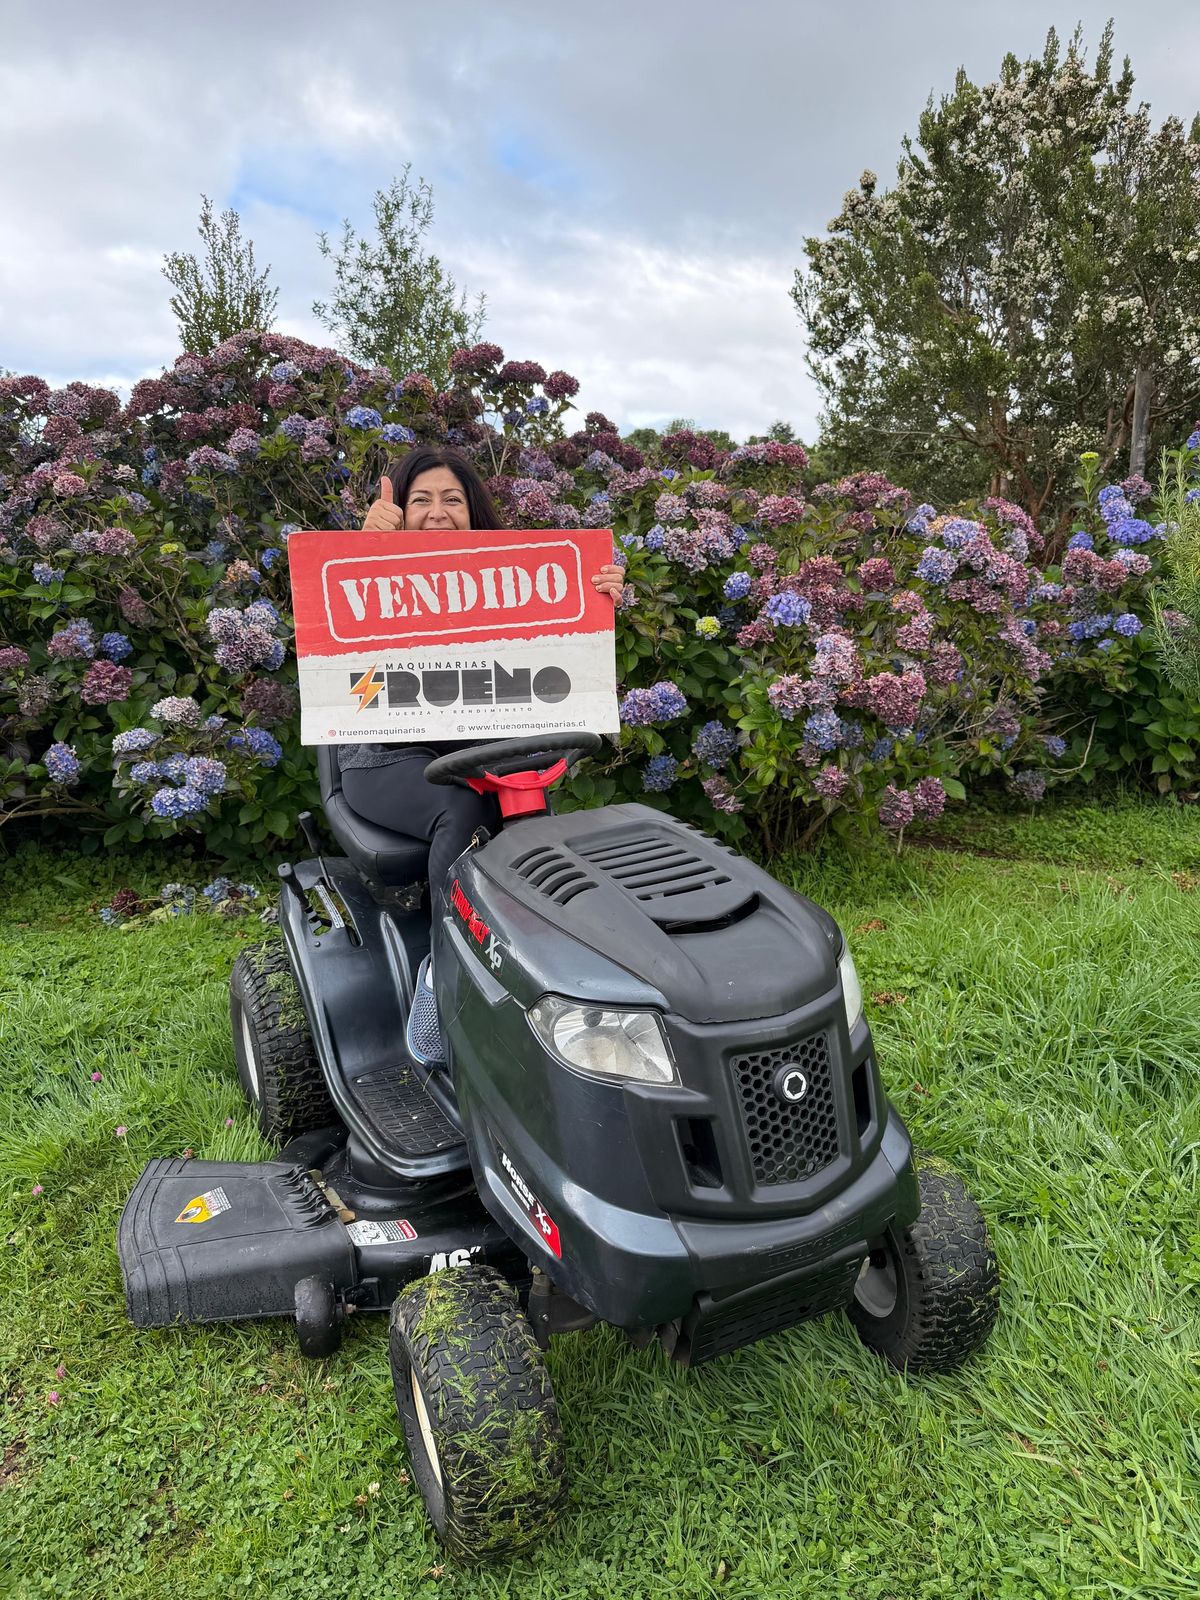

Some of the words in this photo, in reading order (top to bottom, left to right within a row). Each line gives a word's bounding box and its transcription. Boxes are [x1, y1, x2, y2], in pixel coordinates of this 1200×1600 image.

[339, 562, 567, 621] VENDIDO
[386, 660, 487, 671] MAQUINARIAS
[339, 726, 426, 738] truenomaquinarias
[468, 719, 586, 732] www.truenomaquinarias.cl
[502, 1152, 536, 1206] HORSE
